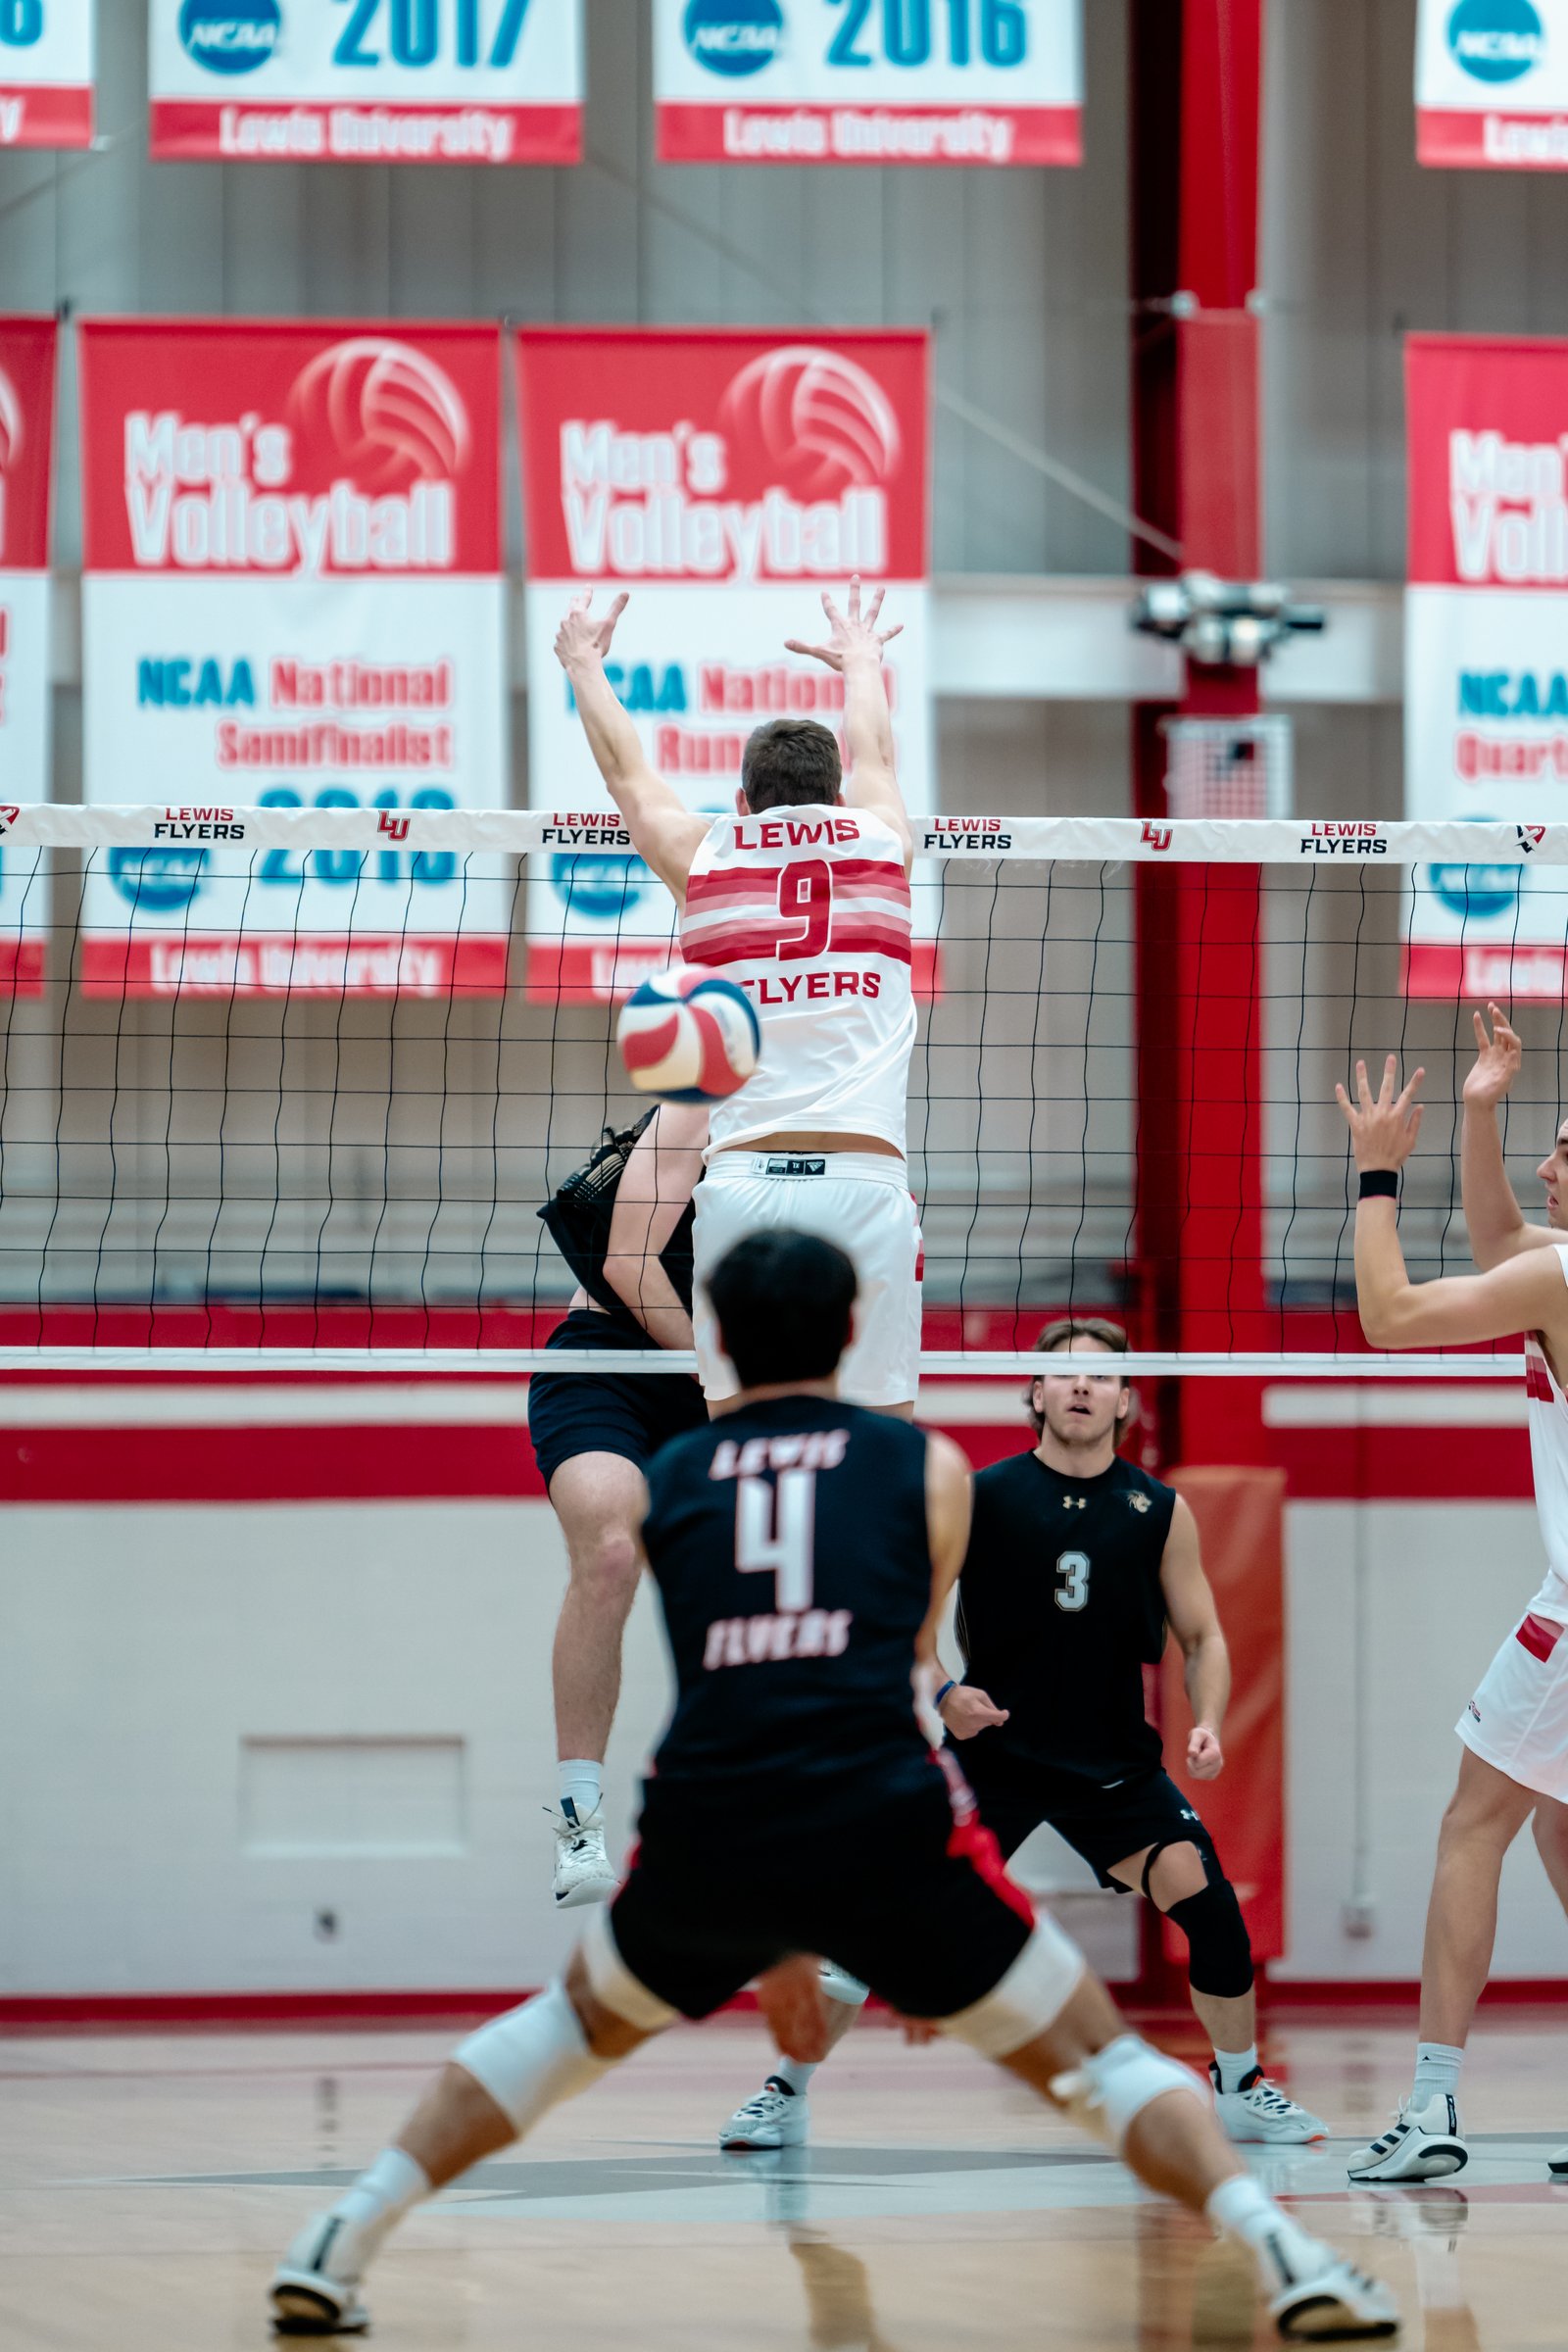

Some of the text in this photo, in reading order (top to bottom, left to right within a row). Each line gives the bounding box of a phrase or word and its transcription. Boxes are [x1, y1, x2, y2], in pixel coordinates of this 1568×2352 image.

[332, 0, 532, 67] 2017
[826, 0, 1027, 66] 2016
[329, 107, 514, 163] University
[124, 411, 290, 486] Men's
[560, 418, 727, 495] Men's
[124, 478, 456, 580] Volleyball
[561, 484, 888, 586] Volleyball
[138, 657, 452, 710] NCAA National
[1457, 672, 1568, 716] NCAA
[217, 718, 453, 770] Semifinalist
[154, 823, 245, 840] FLYERS
[165, 807, 234, 821] LEWIS
[377, 809, 411, 842] LU
[541, 828, 630, 846] FLYERS
[552, 812, 620, 827] LEWIS
[733, 819, 860, 851] LEWIS
[934, 817, 1002, 832] LEWIS
[1140, 820, 1174, 853] LU
[1311, 822, 1377, 837] LEWIS
[923, 834, 1012, 850] FLYERS
[1300, 838, 1388, 855] FLYERS
[775, 858, 833, 962] 9
[735, 1470, 817, 1616] 4
[1054, 1550, 1091, 1612] 3
